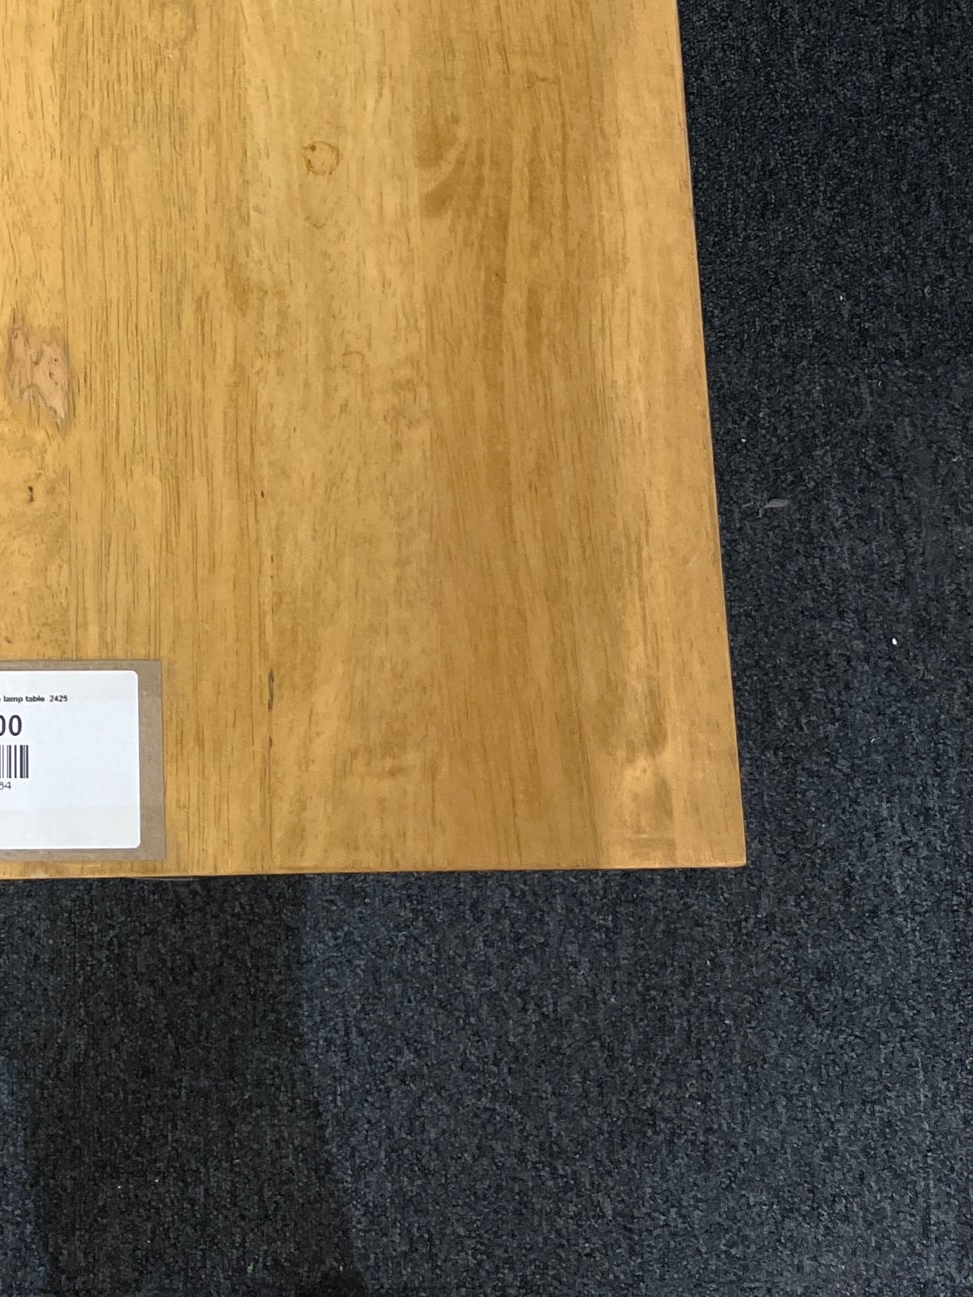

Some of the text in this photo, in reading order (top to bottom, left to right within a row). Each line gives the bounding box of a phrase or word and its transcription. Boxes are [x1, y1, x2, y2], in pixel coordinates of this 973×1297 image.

[3, 695, 23, 704] lamp
[25, 695, 45, 703] table
[49, 694, 68, 703] 2425
